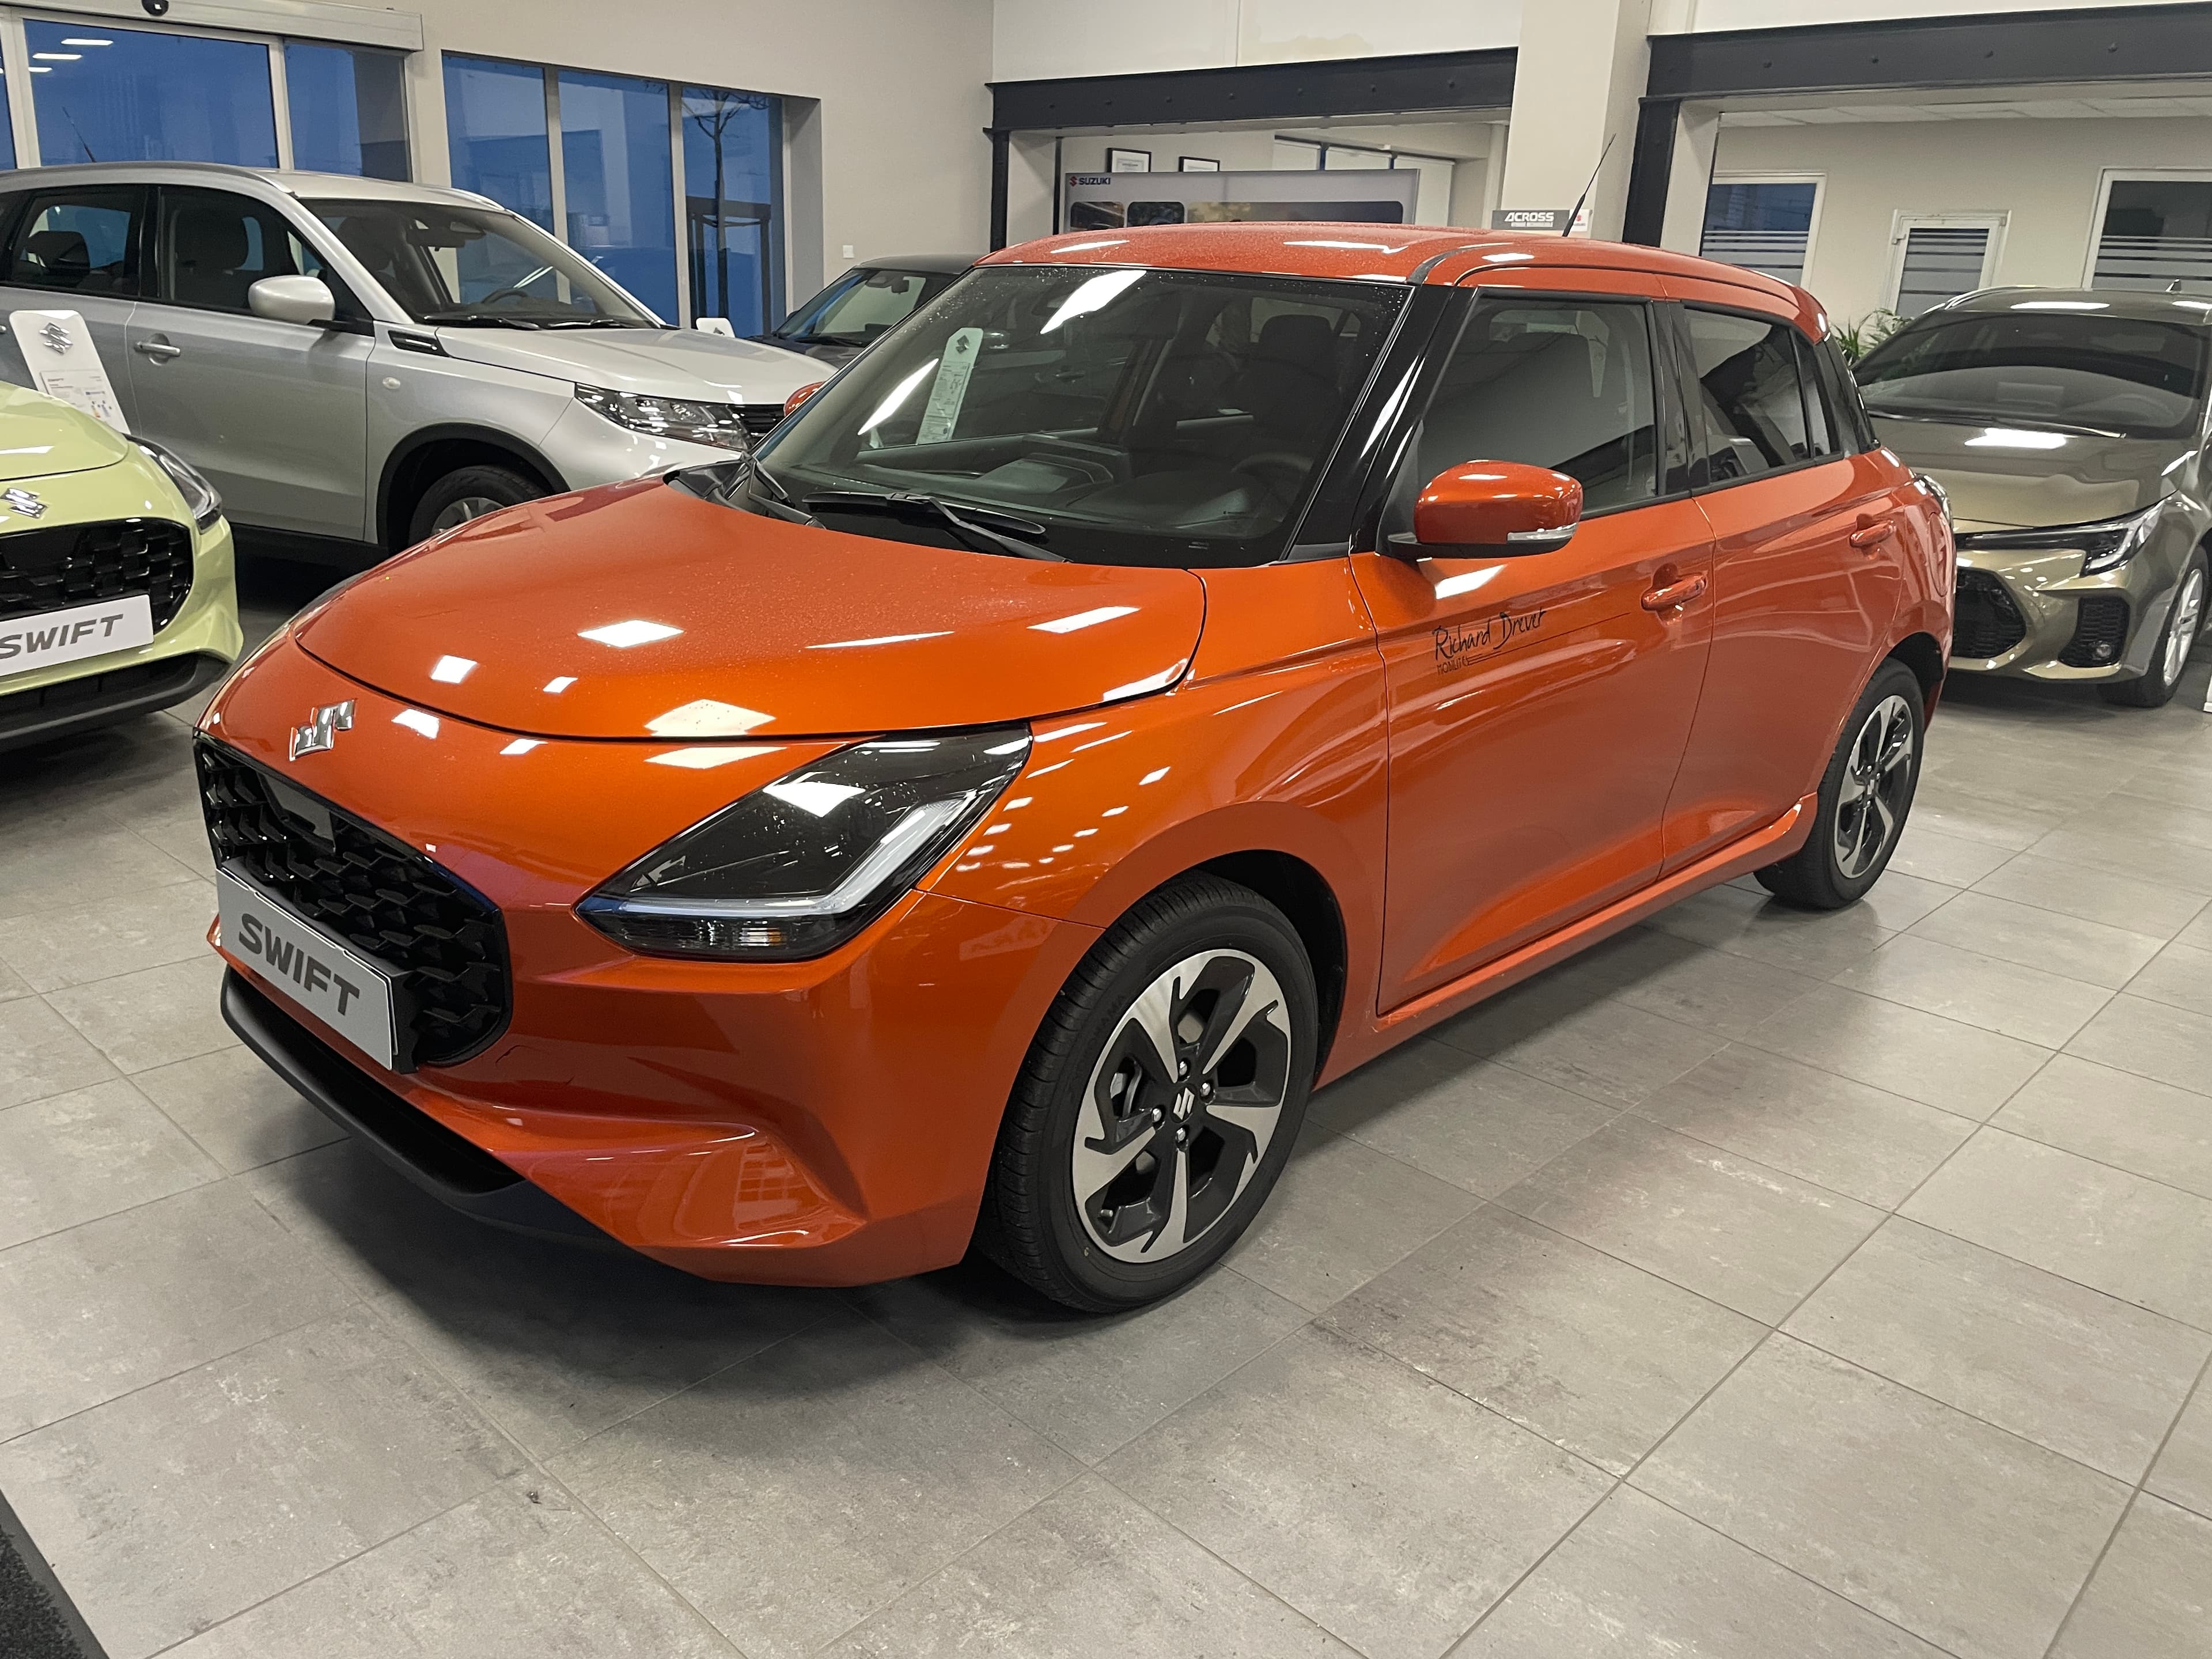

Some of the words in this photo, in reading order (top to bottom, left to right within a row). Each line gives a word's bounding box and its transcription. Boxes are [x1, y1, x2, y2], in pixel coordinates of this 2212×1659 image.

[1504, 212, 1554, 222] ACROSS
[0, 613, 124, 660] SWIFT
[1432, 619, 1491, 661] Richard
[238, 912, 360, 1016] SWIFT
